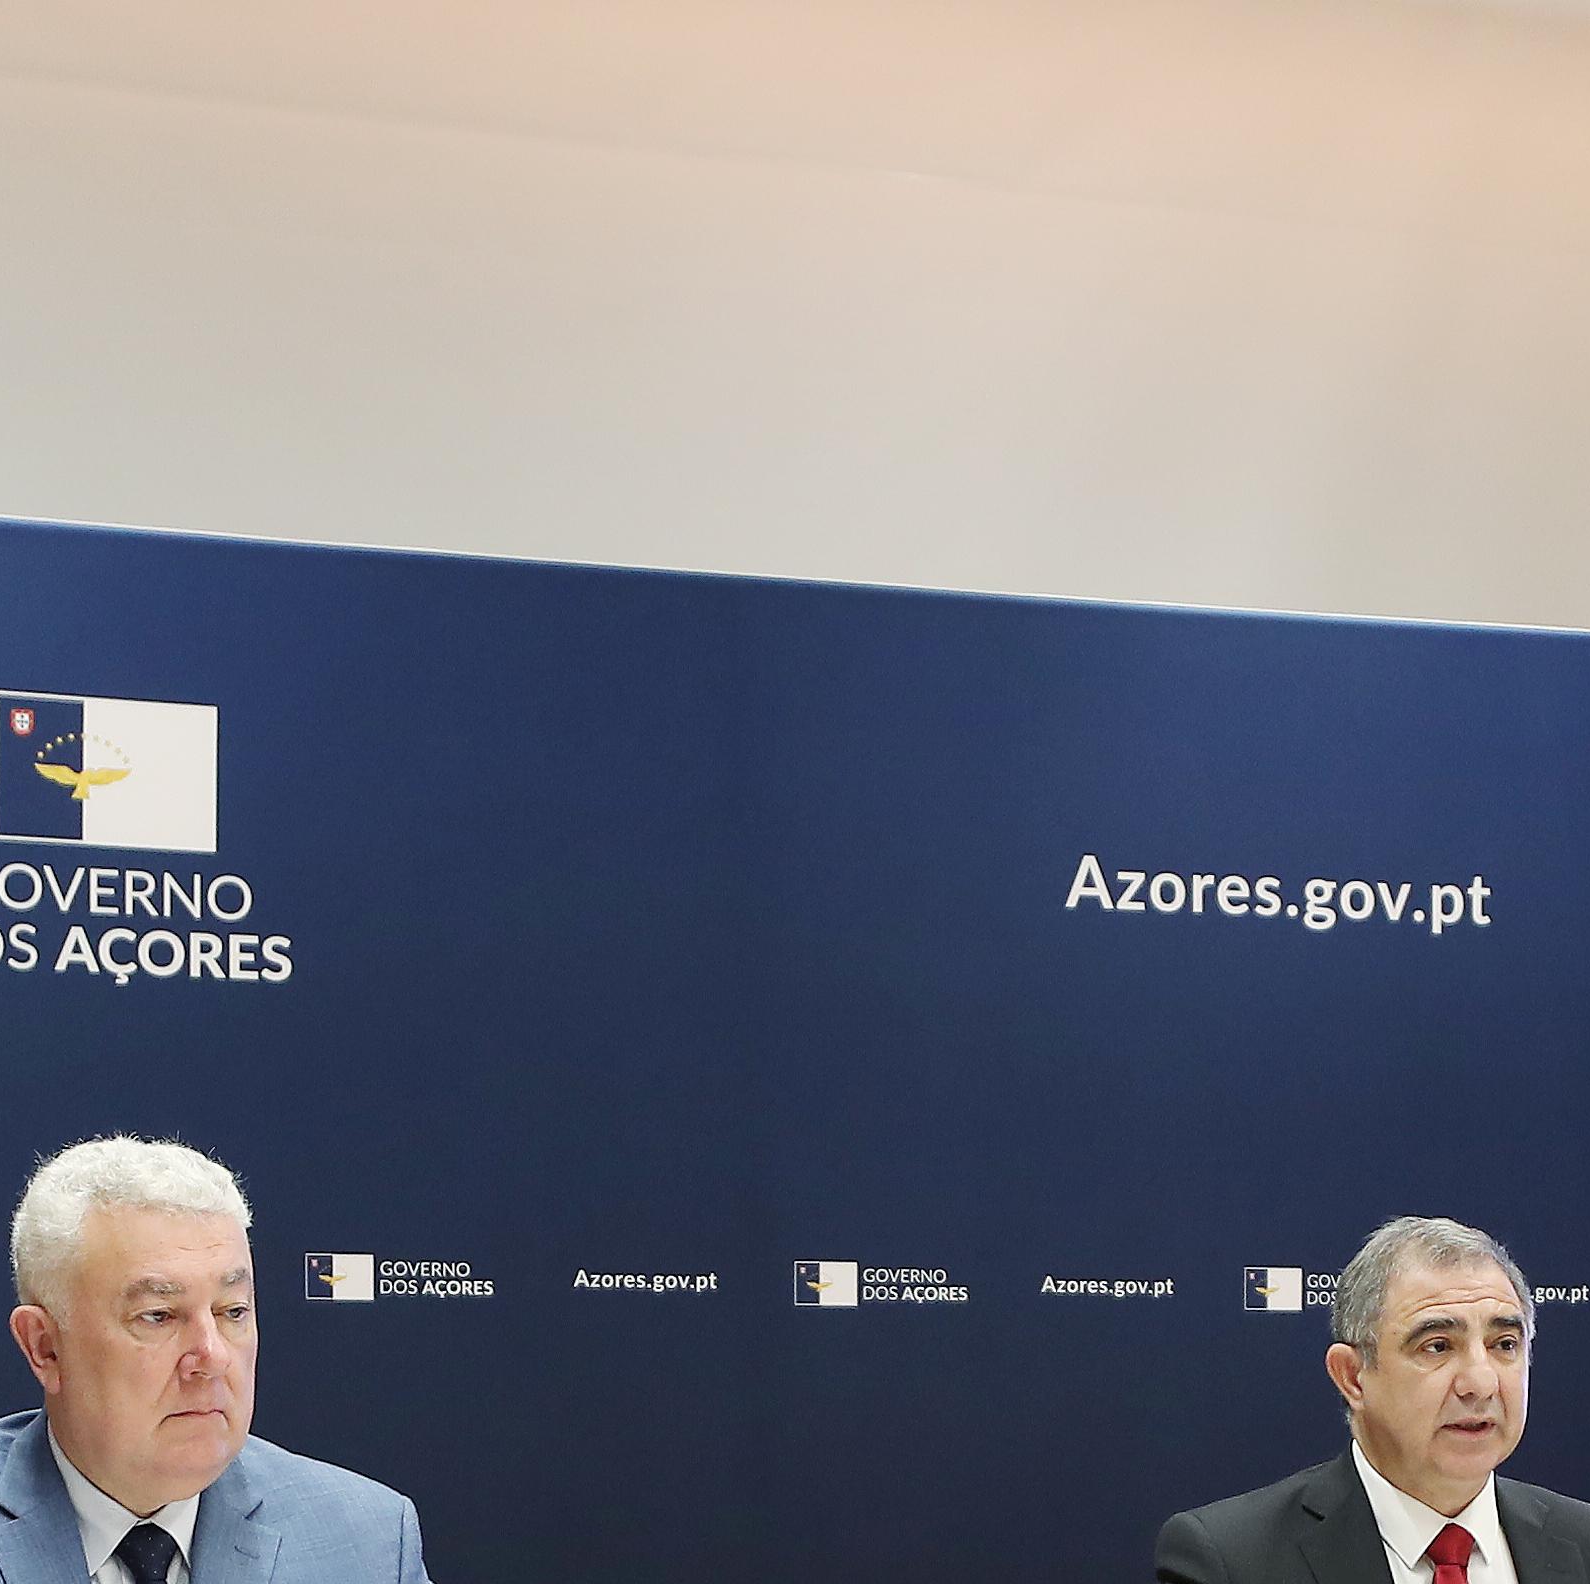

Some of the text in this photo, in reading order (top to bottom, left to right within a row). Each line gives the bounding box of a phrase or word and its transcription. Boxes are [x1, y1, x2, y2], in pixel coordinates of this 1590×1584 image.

[1065, 854, 1492, 936] Azores.gov.pt
[54, 925, 294, 985] AÇORES
[379, 1260, 471, 1278] GOVERNO
[862, 1268, 947, 1284] GOVERNO
[379, 1279, 494, 1298] DOS AÇORES
[573, 1269, 718, 1293] Azores.gov.pt
[1040, 1275, 1174, 1299] Azores.gov.pt
[862, 1285, 969, 1304] DOS AÇORES
[1530, 1285, 1590, 1304] .gov.pt
